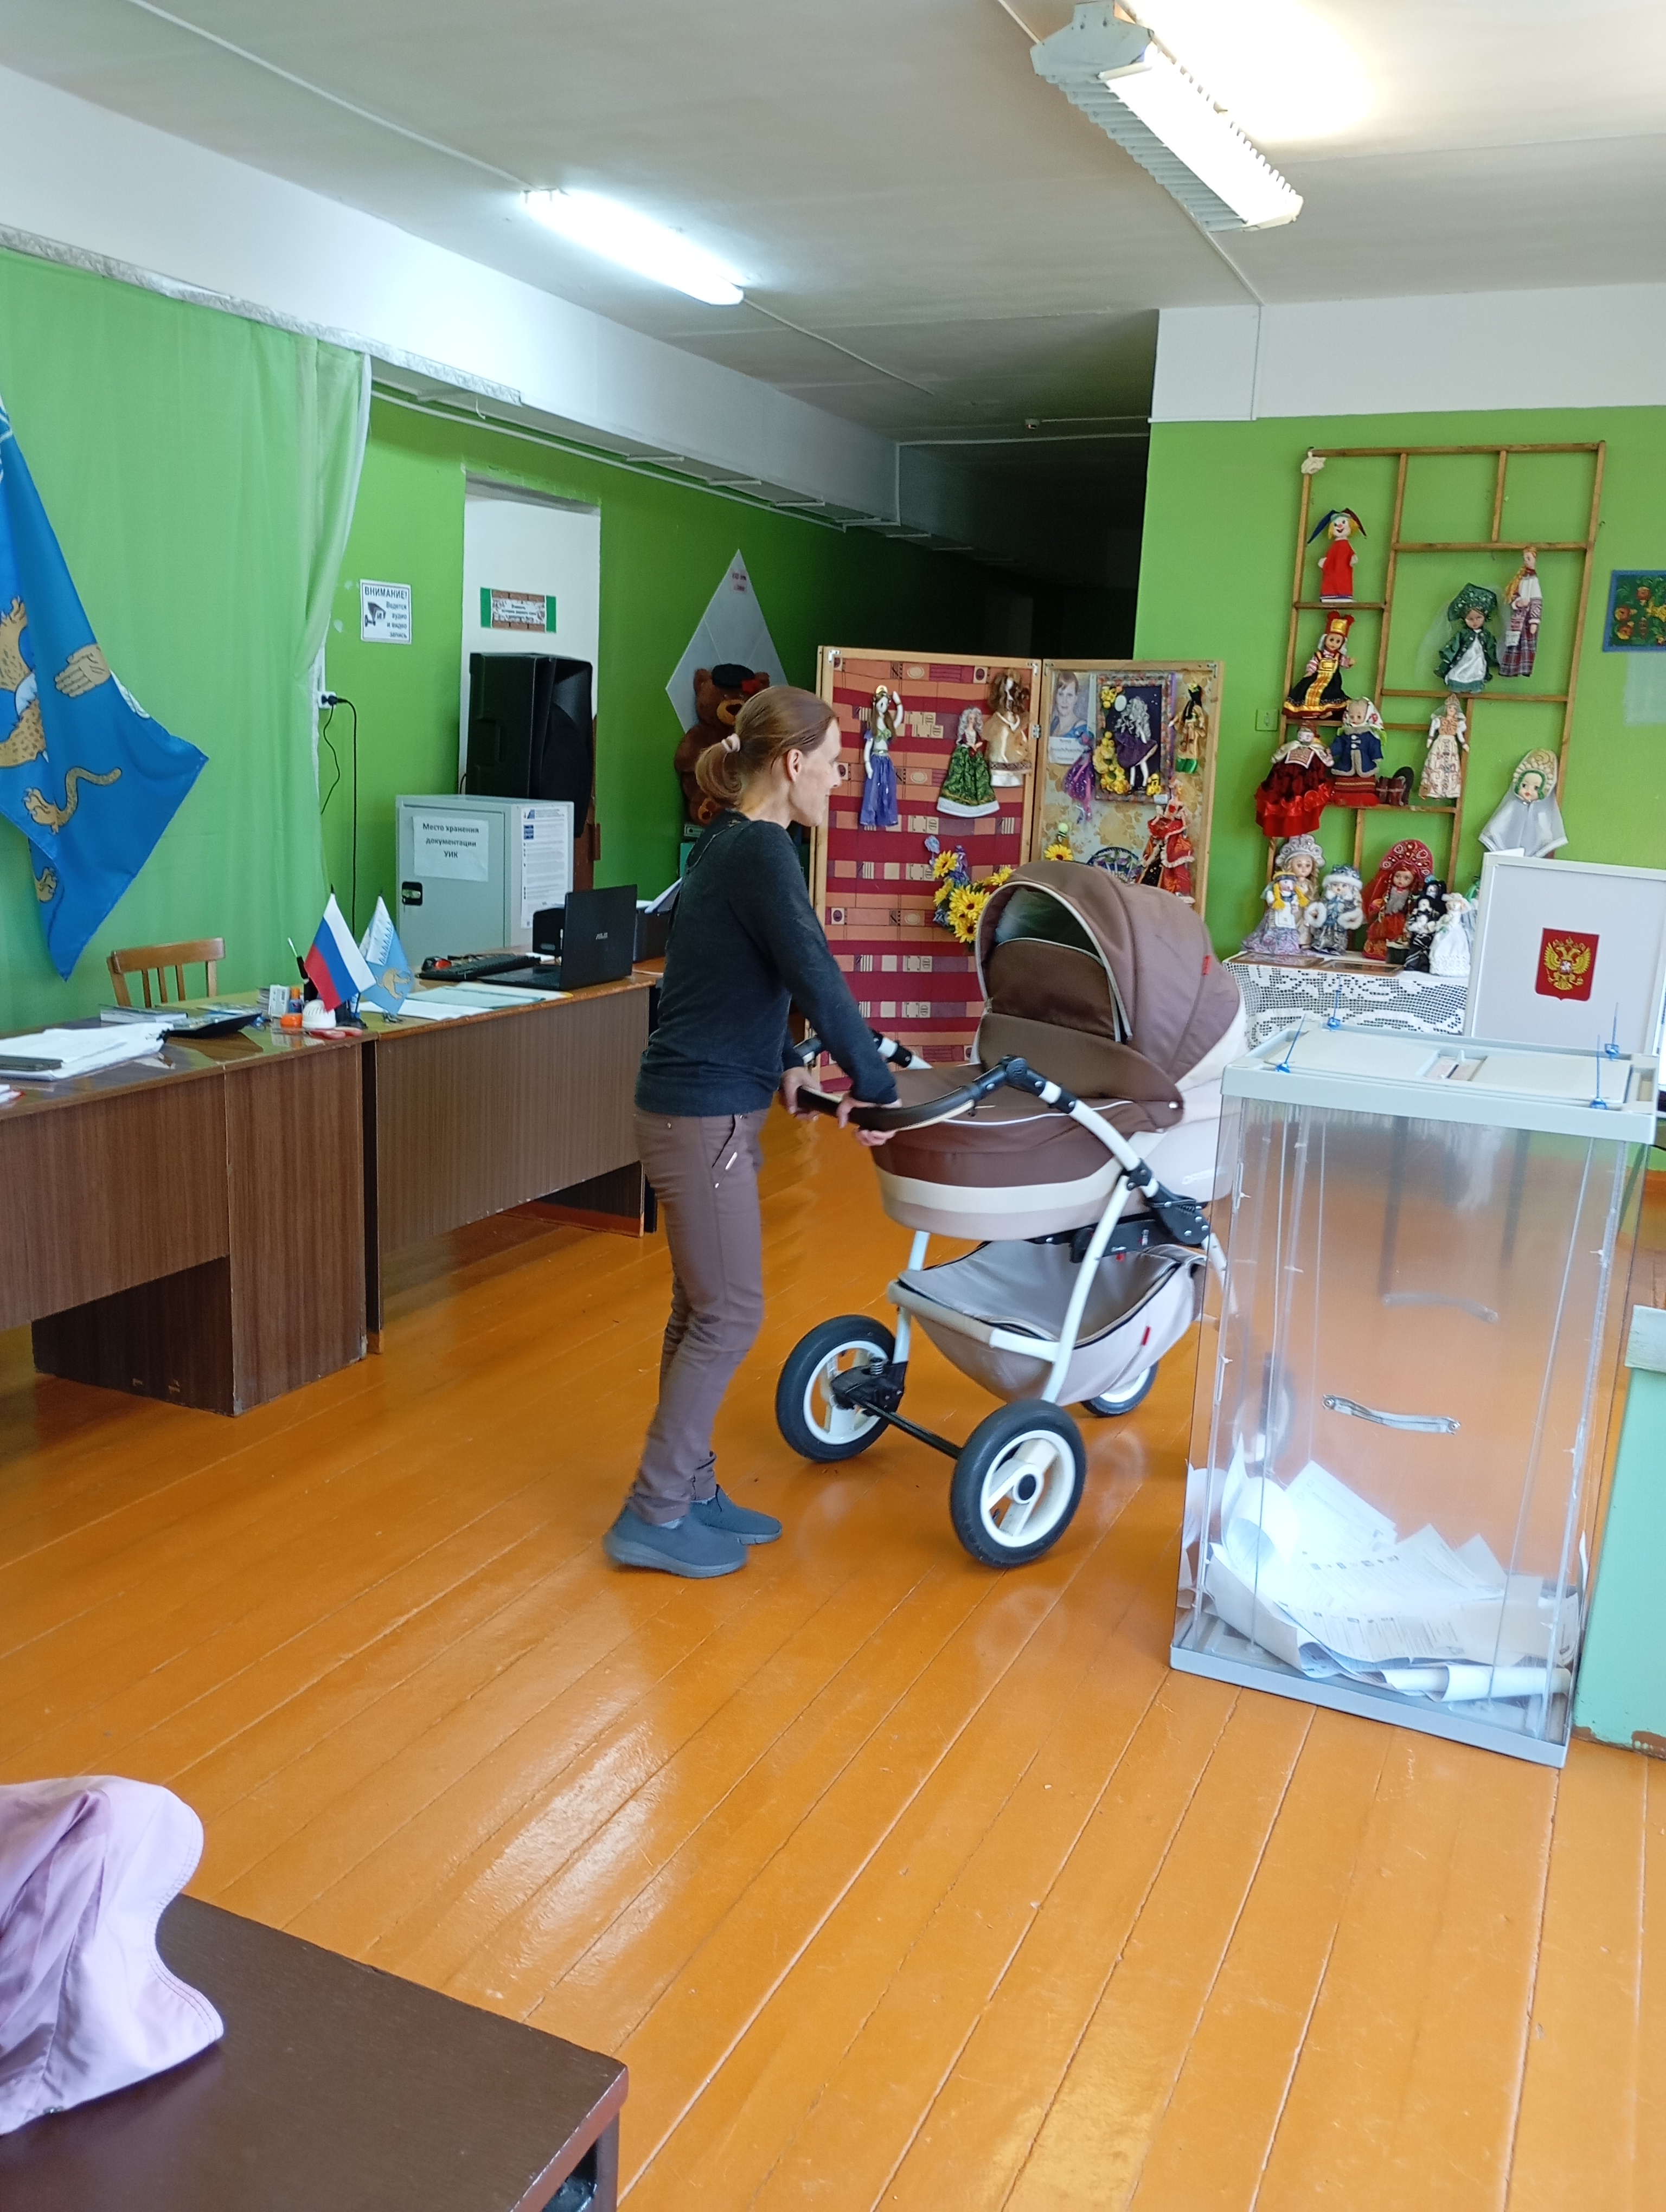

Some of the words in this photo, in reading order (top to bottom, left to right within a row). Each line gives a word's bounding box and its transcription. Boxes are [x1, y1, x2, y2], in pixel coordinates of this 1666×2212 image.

[365, 586, 407, 599] ВНИМАНИЕ!
[423, 822, 444, 831] Место
[445, 825, 479, 833] хранения
[426, 838, 477, 847] документации
[444, 850, 458, 858] УИК
